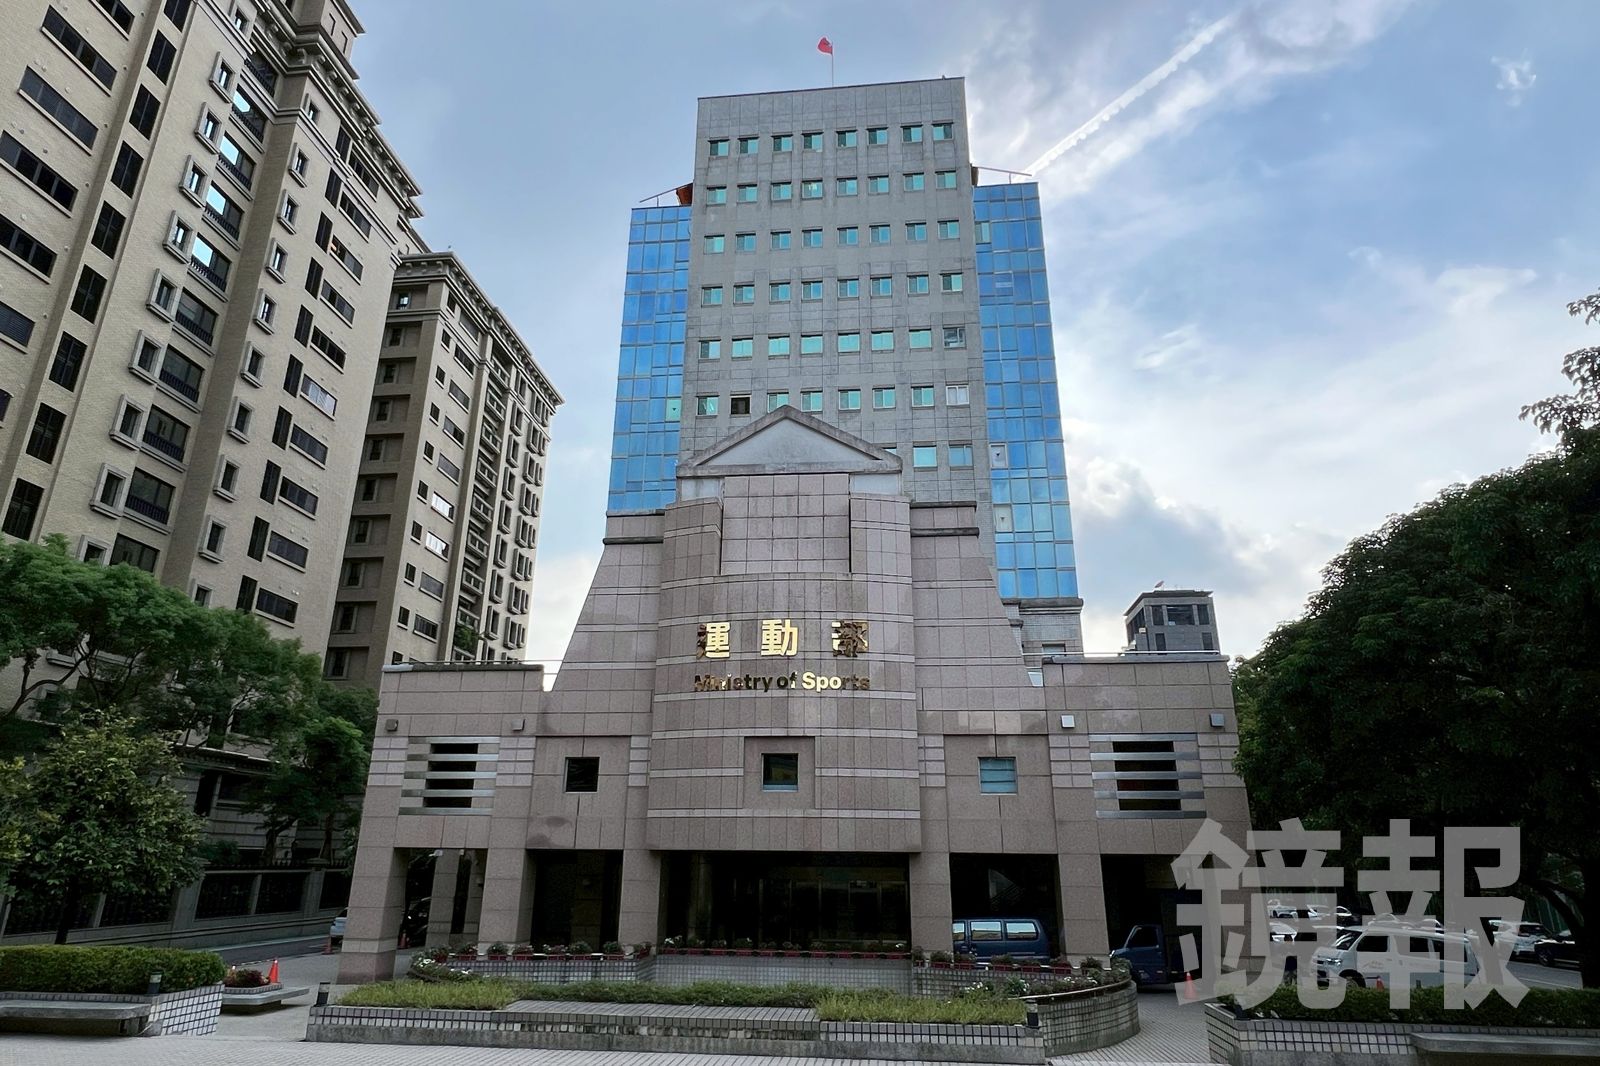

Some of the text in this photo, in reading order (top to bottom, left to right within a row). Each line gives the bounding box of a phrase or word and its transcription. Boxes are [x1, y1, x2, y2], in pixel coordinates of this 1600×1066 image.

[697, 619, 869, 658] 運動部
[695, 671, 870, 693] Ministry of Sports
